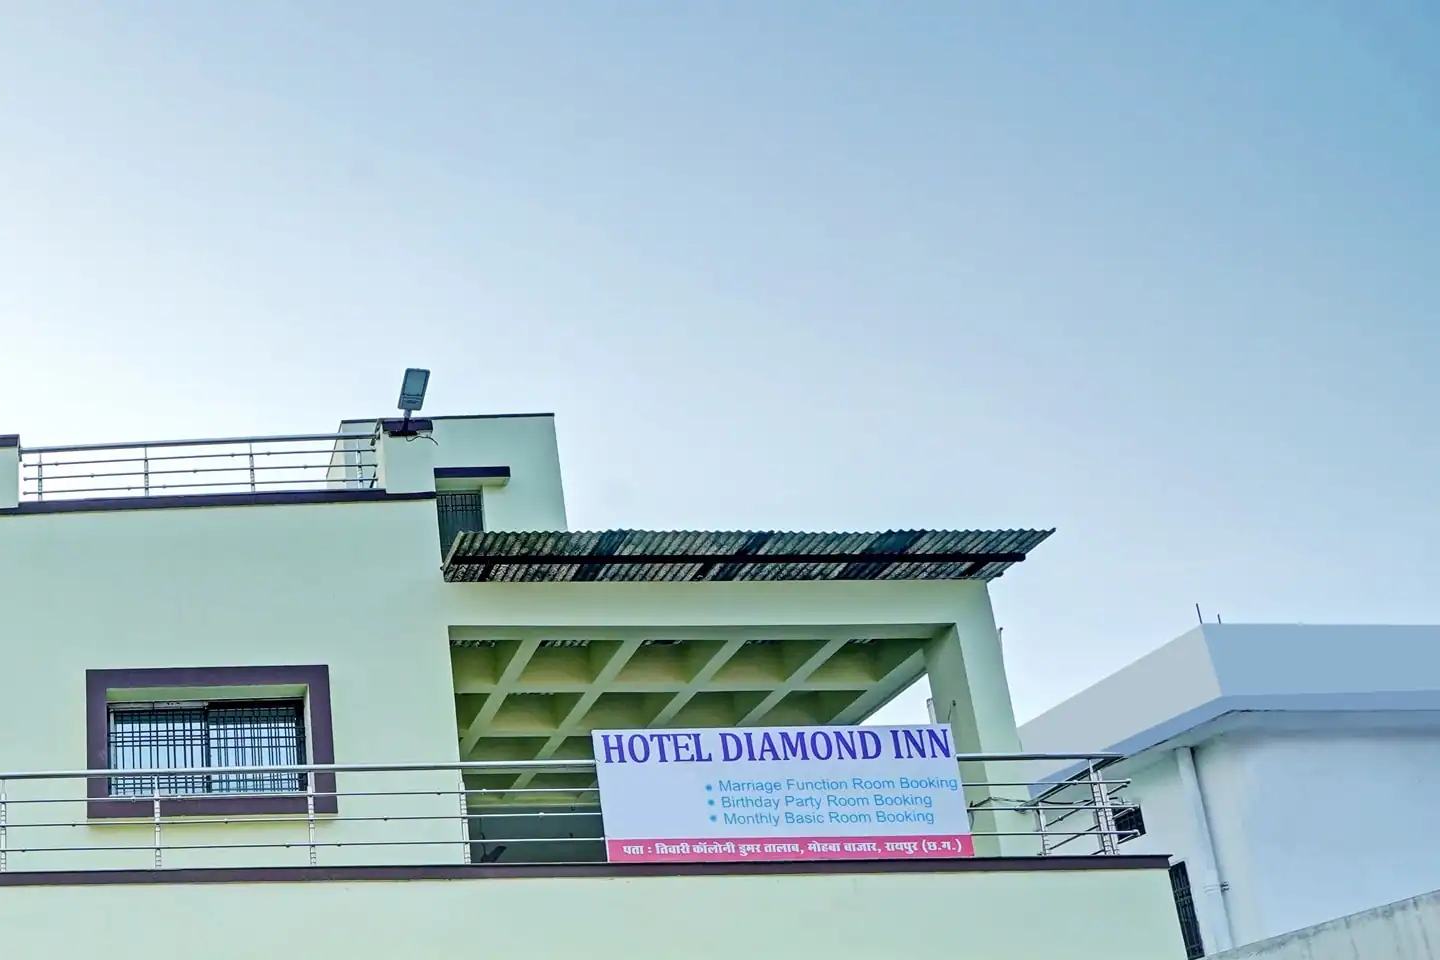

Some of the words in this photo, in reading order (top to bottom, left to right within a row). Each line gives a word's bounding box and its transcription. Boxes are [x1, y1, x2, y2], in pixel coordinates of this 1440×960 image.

[602, 733, 712, 763] HOTEL
[719, 731, 882, 761] DIAMOND
[891, 729, 950, 759] INN
[719, 779, 781, 794] Marriage
[787, 778, 848, 791] Function
[852, 778, 896, 790] Room
[900, 776, 957, 791] Booking
[722, 795, 780, 810] Birthday
[785, 795, 821, 810] Party
[828, 795, 871, 807] Room
[875, 794, 932, 808] Booking
[724, 811, 779, 826] Monthly
[785, 811, 824, 824] Basic
[829, 811, 871, 823] Room
[875, 810, 934, 825] Booking
